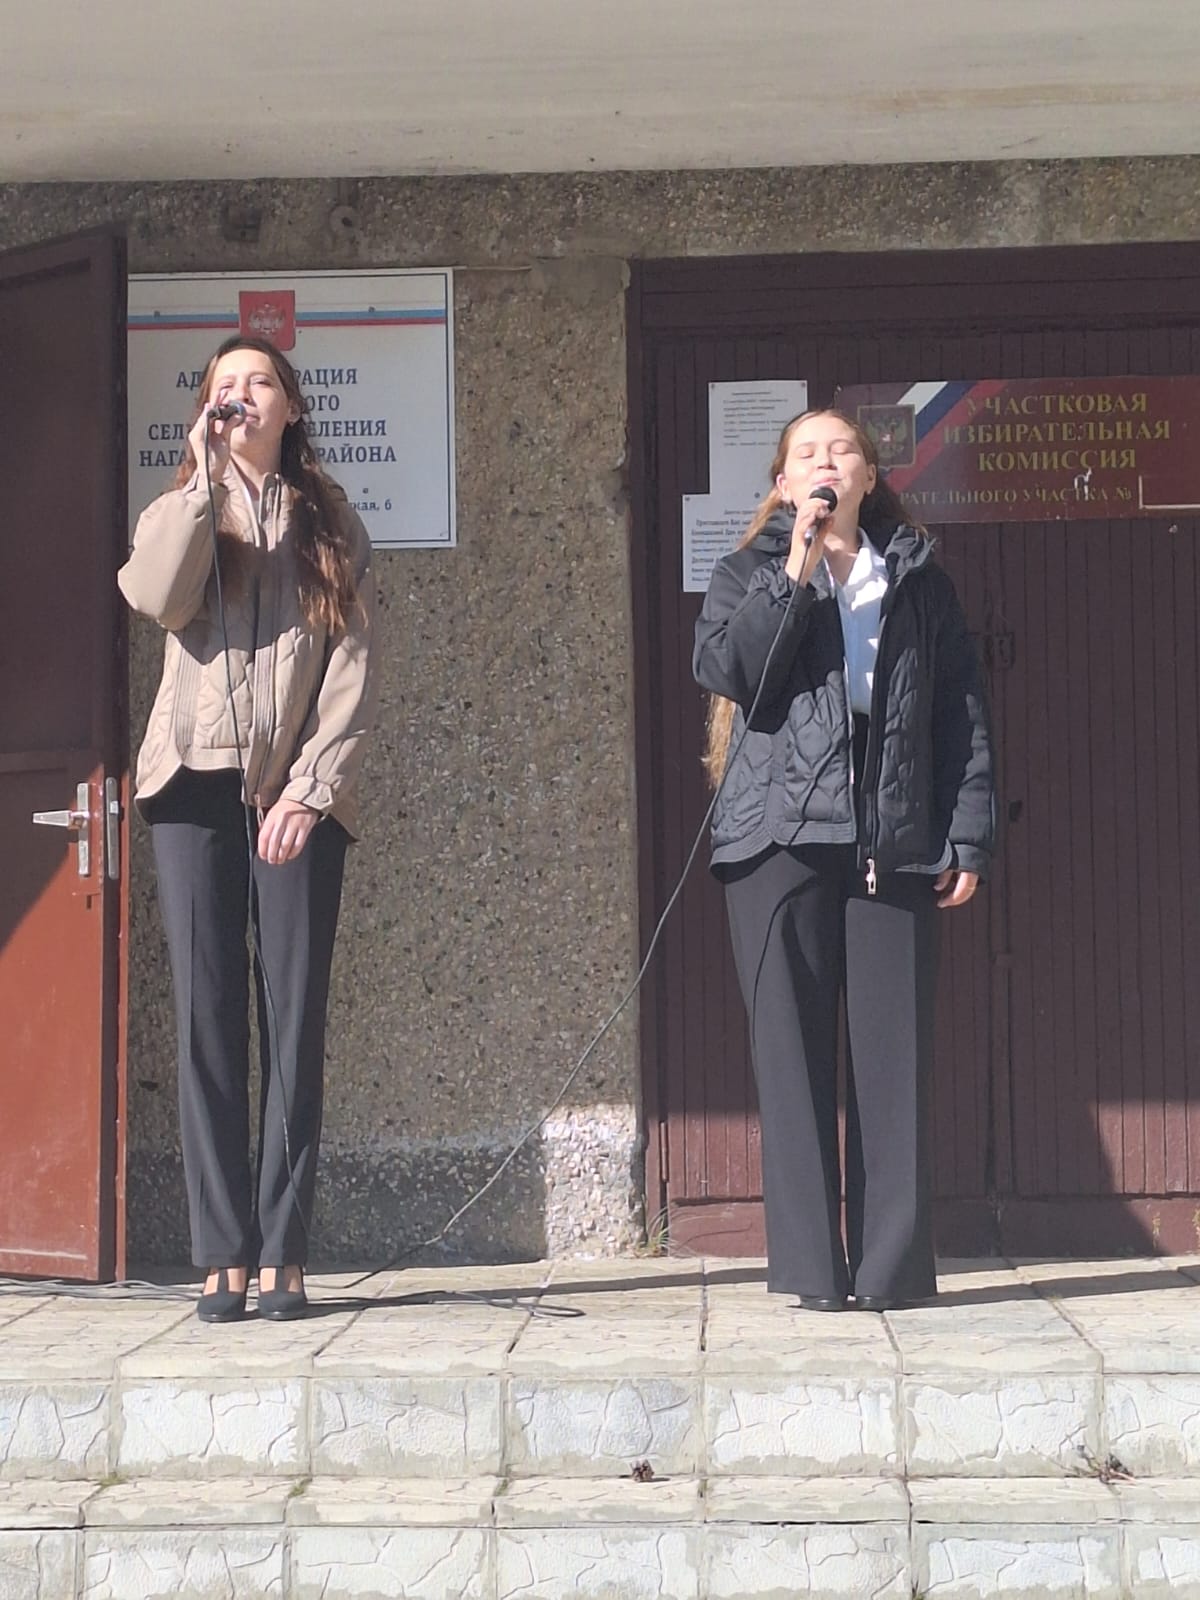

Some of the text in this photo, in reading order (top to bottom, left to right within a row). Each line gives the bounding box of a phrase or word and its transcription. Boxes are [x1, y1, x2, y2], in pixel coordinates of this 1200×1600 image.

[966, 392, 1147, 416] УЧАСТКОВАЯ
[943, 420, 1170, 444] ИЗБИРАТЕЛЬНАЯ
[316, 443, 397, 464] РАЙОНА
[979, 448, 1136, 471] КОМИССИЯ
